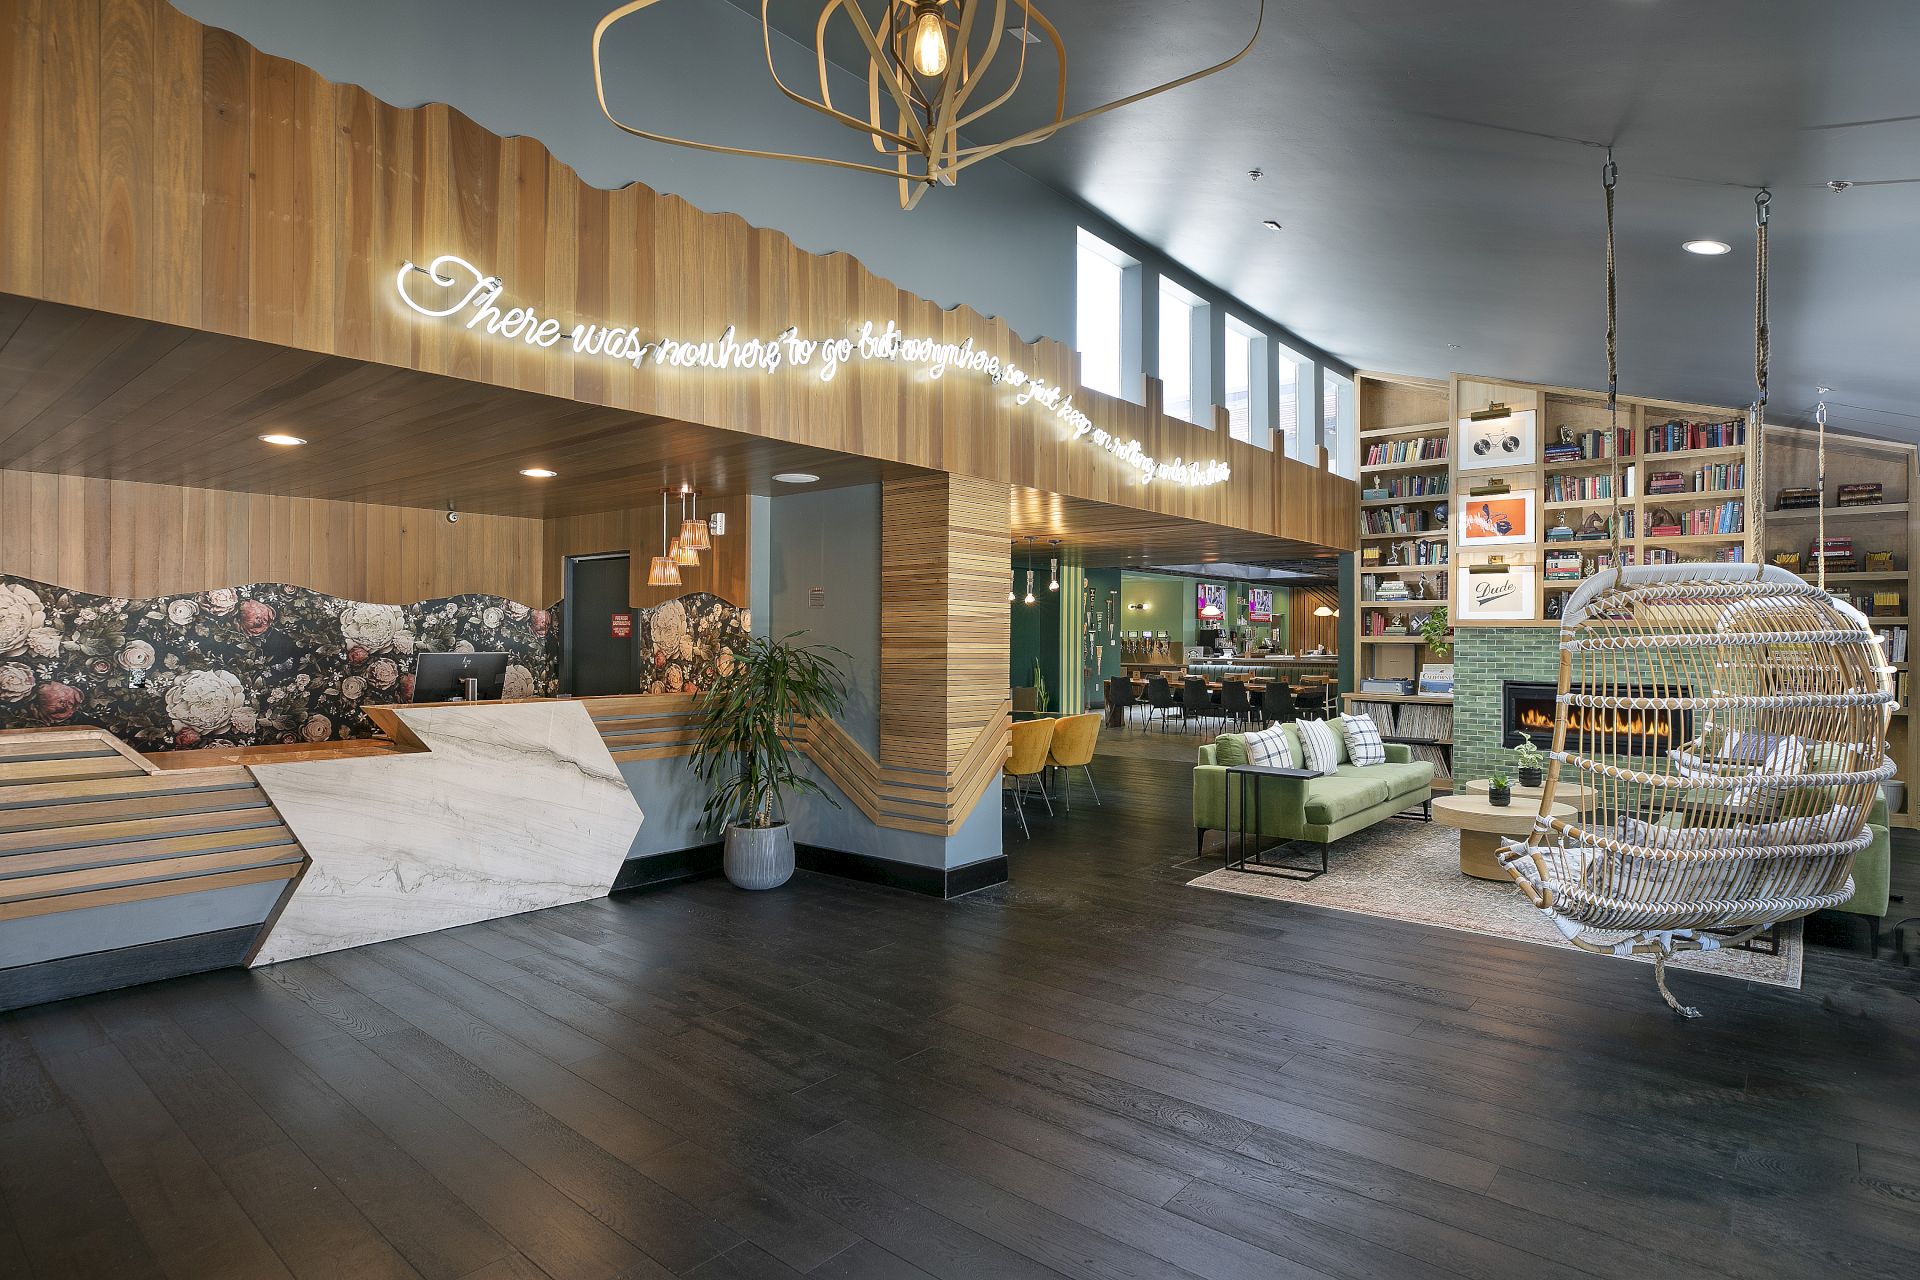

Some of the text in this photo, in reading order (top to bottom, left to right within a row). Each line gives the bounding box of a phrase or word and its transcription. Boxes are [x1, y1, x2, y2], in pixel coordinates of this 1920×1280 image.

[397, 255, 561, 347] There
[571, 324, 648, 360] was
[655, 325, 781, 371] nowhere
[783, 326, 816, 366] to
[822, 338, 852, 382] go
[859, 320, 898, 360] but
[1017, 378, 1060, 411] just
[1057, 395, 1092, 440] keep
[1094, 428, 1112, 449] on
[1476, 579, 1516, 599] Dude
